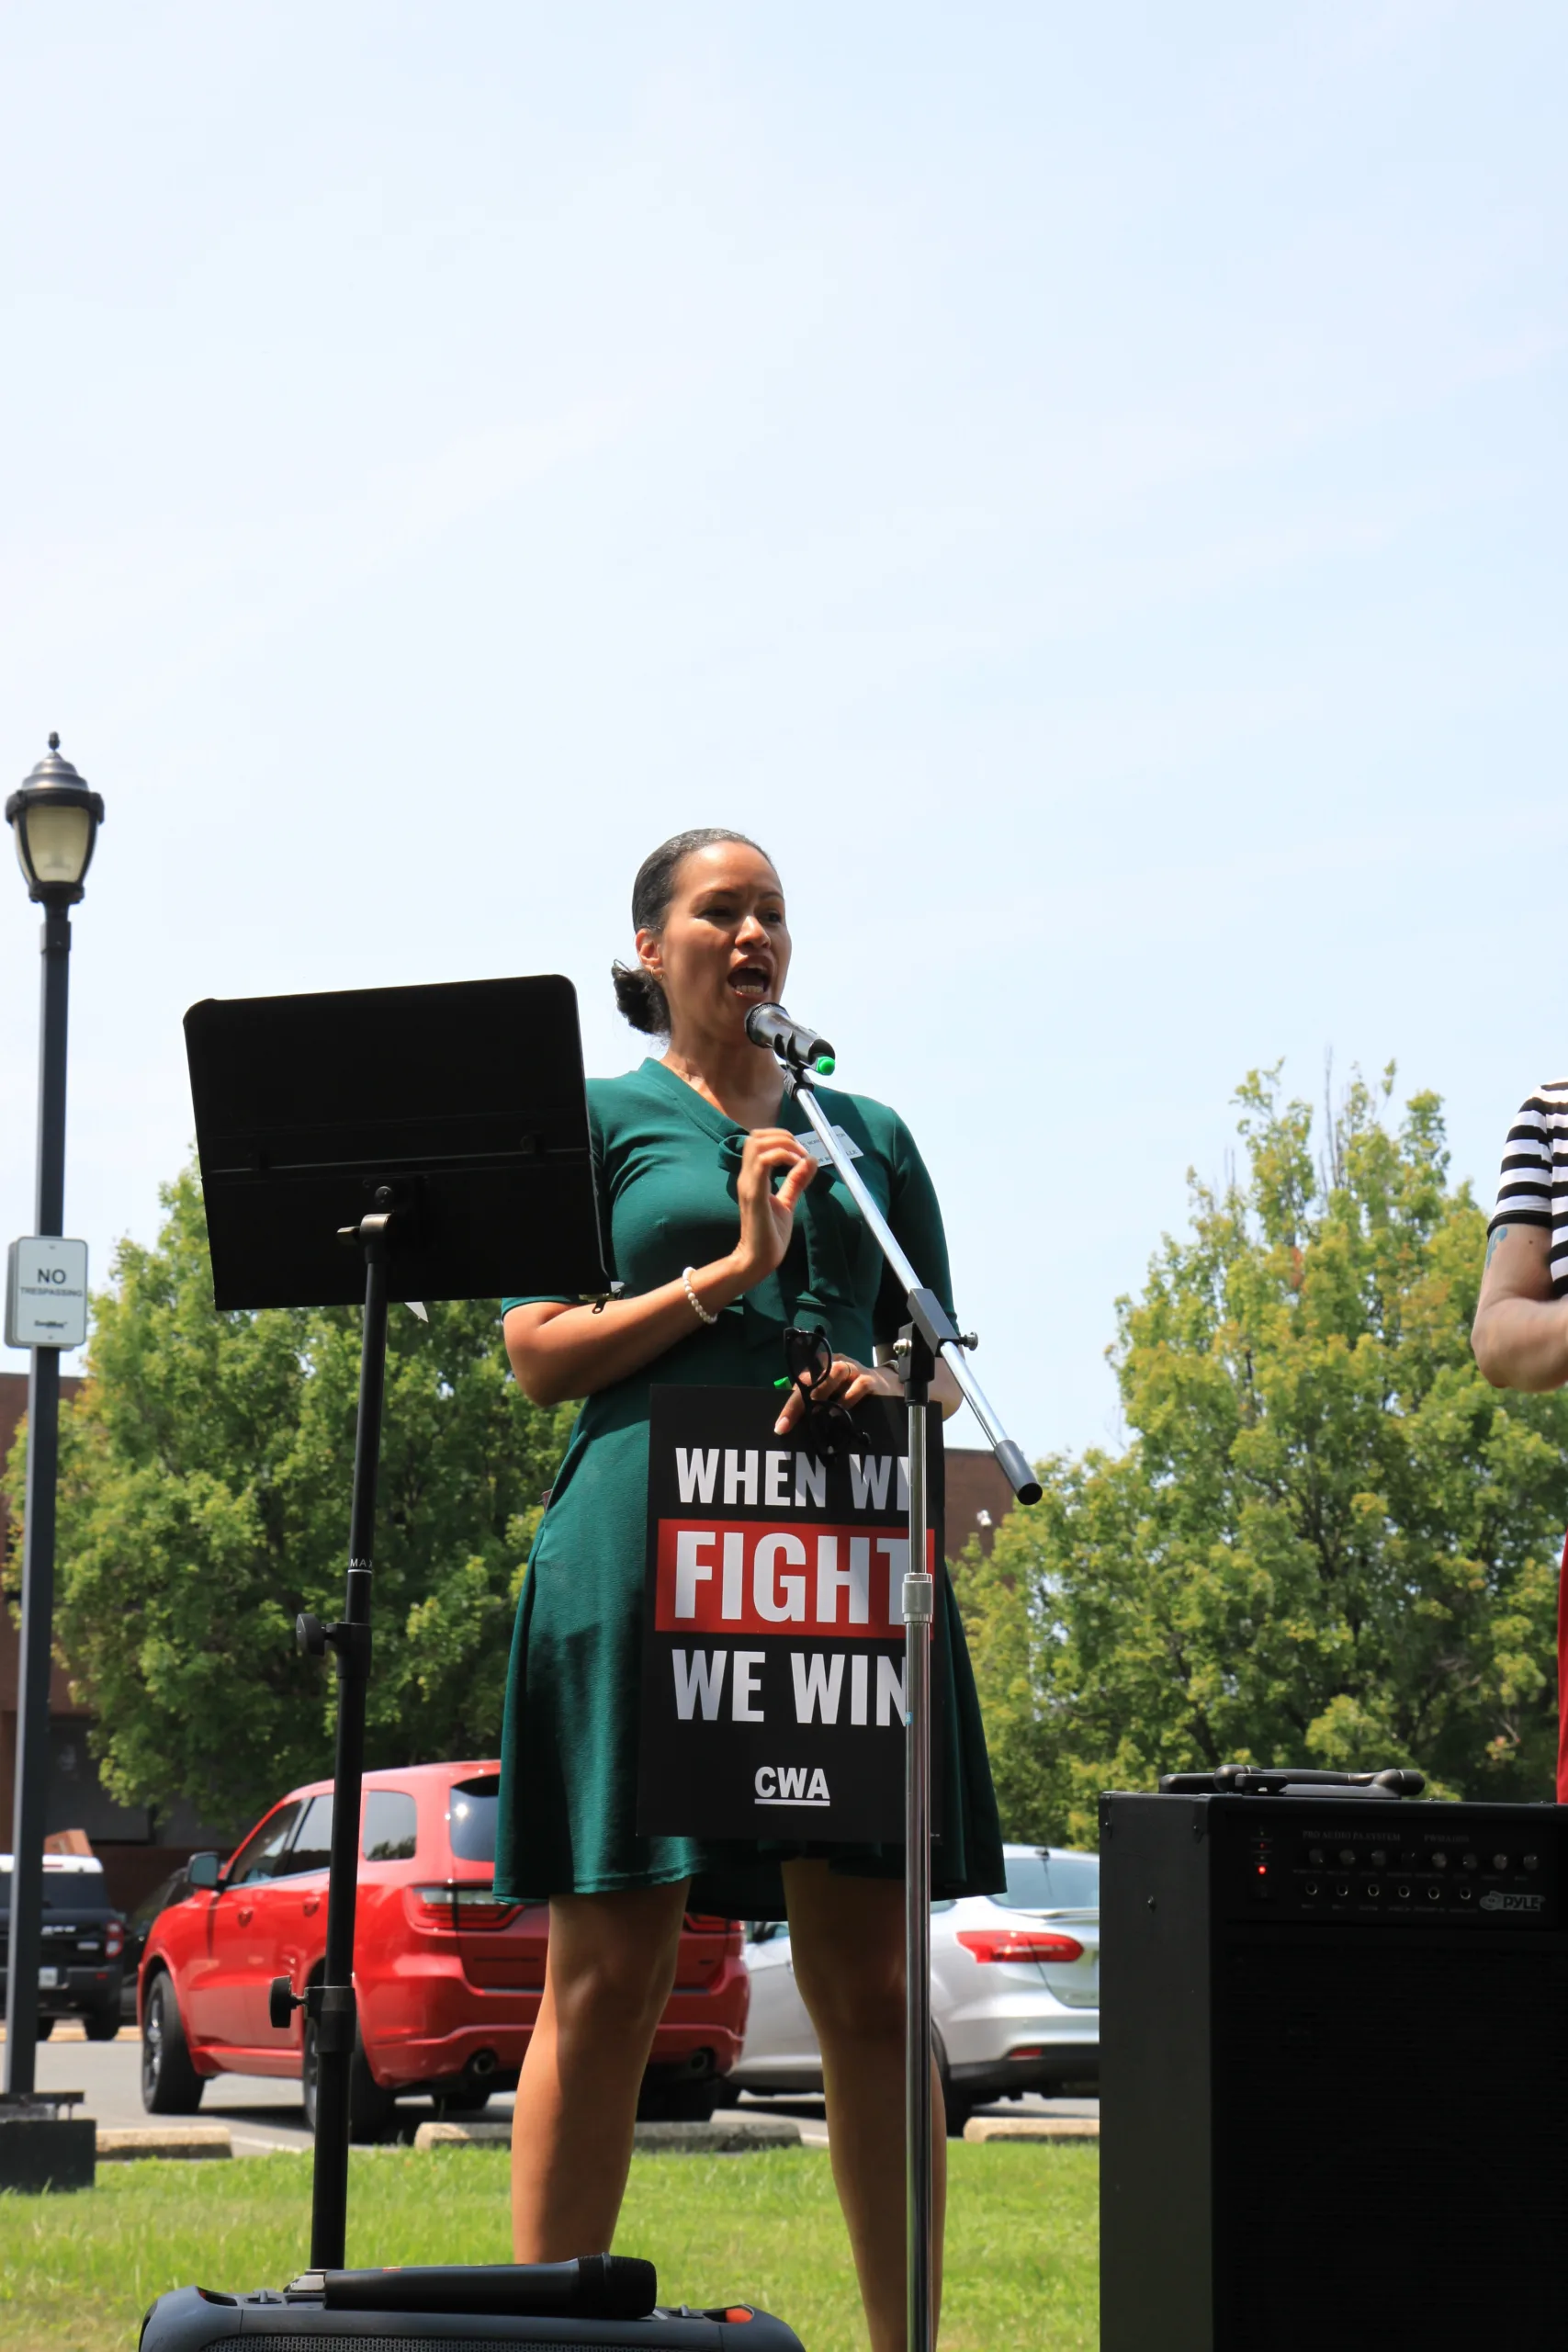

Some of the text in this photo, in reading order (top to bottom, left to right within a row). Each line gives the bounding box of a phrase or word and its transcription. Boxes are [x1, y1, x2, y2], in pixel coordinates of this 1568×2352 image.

[20, 1286, 83, 1297] TRESPASSING
[38, 1268, 67, 1284] NO
[675, 1447, 827, 1508] WHEN
[674, 1531, 909, 1625] FIGHT
[671, 1648, 908, 1726] WE WIN
[754, 1766, 830, 1800] CWA
[1503, 1895, 1539, 1910] PYLE
